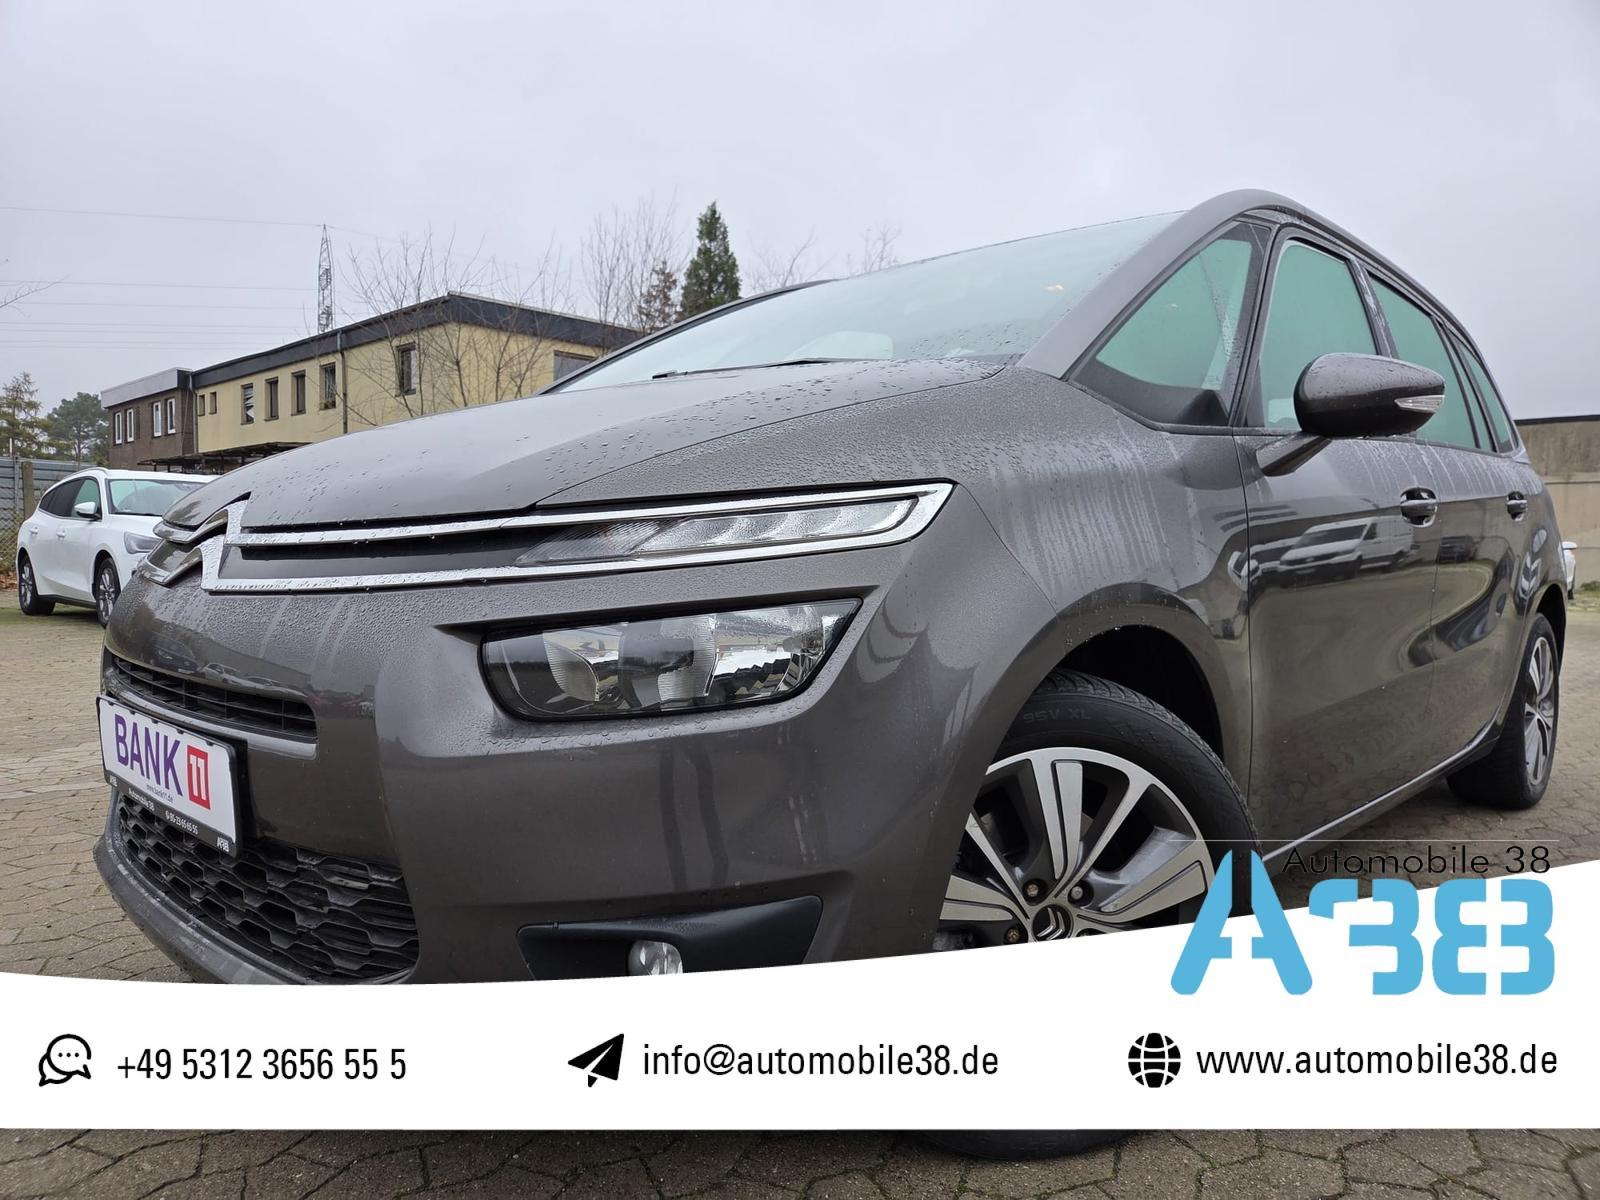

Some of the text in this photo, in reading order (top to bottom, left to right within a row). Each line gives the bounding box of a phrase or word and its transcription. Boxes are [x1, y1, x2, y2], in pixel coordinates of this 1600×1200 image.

[1023, 707, 1093, 724] 95V XL
[114, 713, 184, 797] BANK
